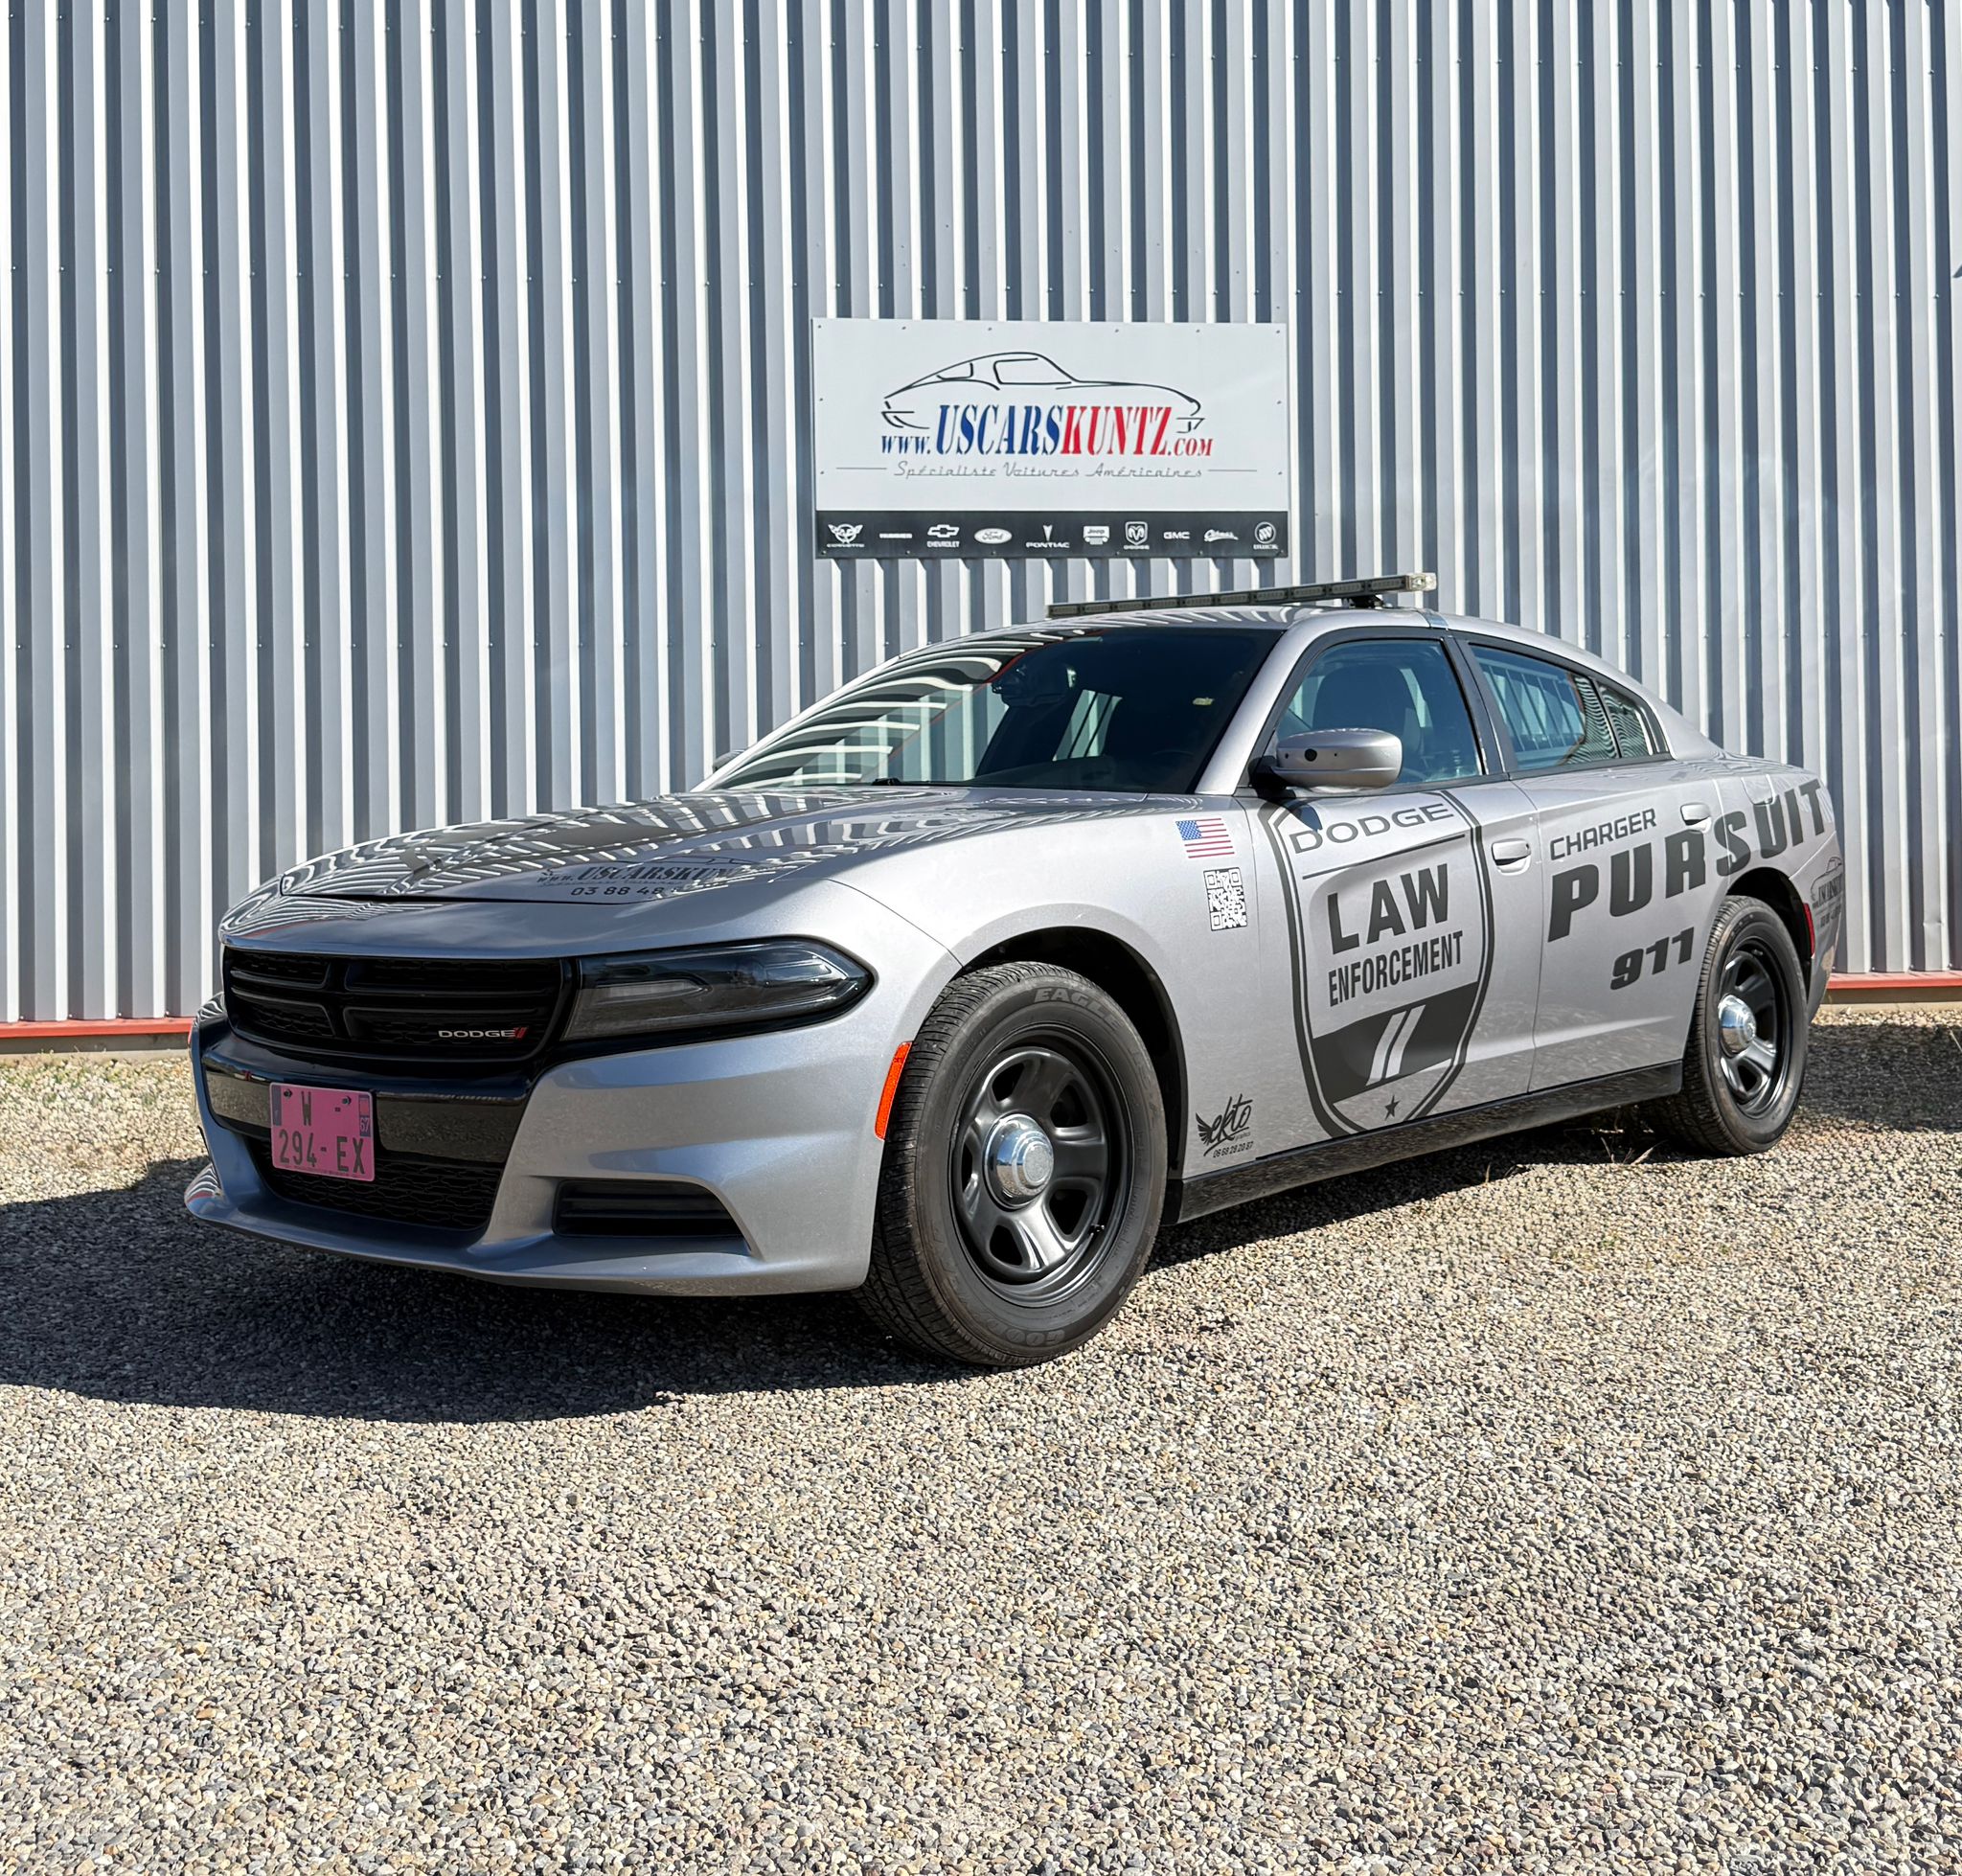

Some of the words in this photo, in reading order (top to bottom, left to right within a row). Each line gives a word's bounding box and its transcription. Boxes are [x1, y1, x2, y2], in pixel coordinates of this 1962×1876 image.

[894, 460, 996, 479] Spécialiste
[1002, 461, 1080, 478] Voitures
[1085, 463, 1202, 478] Américaines
[1163, 531, 1191, 539] GMC
[1289, 802, 1454, 855] DODGE
[1549, 808, 1657, 861] CHARGER
[1547, 778, 1826, 943] PURSUIT
[570, 886, 599, 896] 03
[604, 886, 629, 896] 88
[1327, 863, 1449, 955] LAW
[1328, 930, 1464, 1007] ENFORCEMENT
[1609, 927, 1695, 991] 911
[438, 1029, 516, 1039] DODGE
[1034, 987, 1125, 1032] EAGLE
[301, 1090, 312, 1127] W
